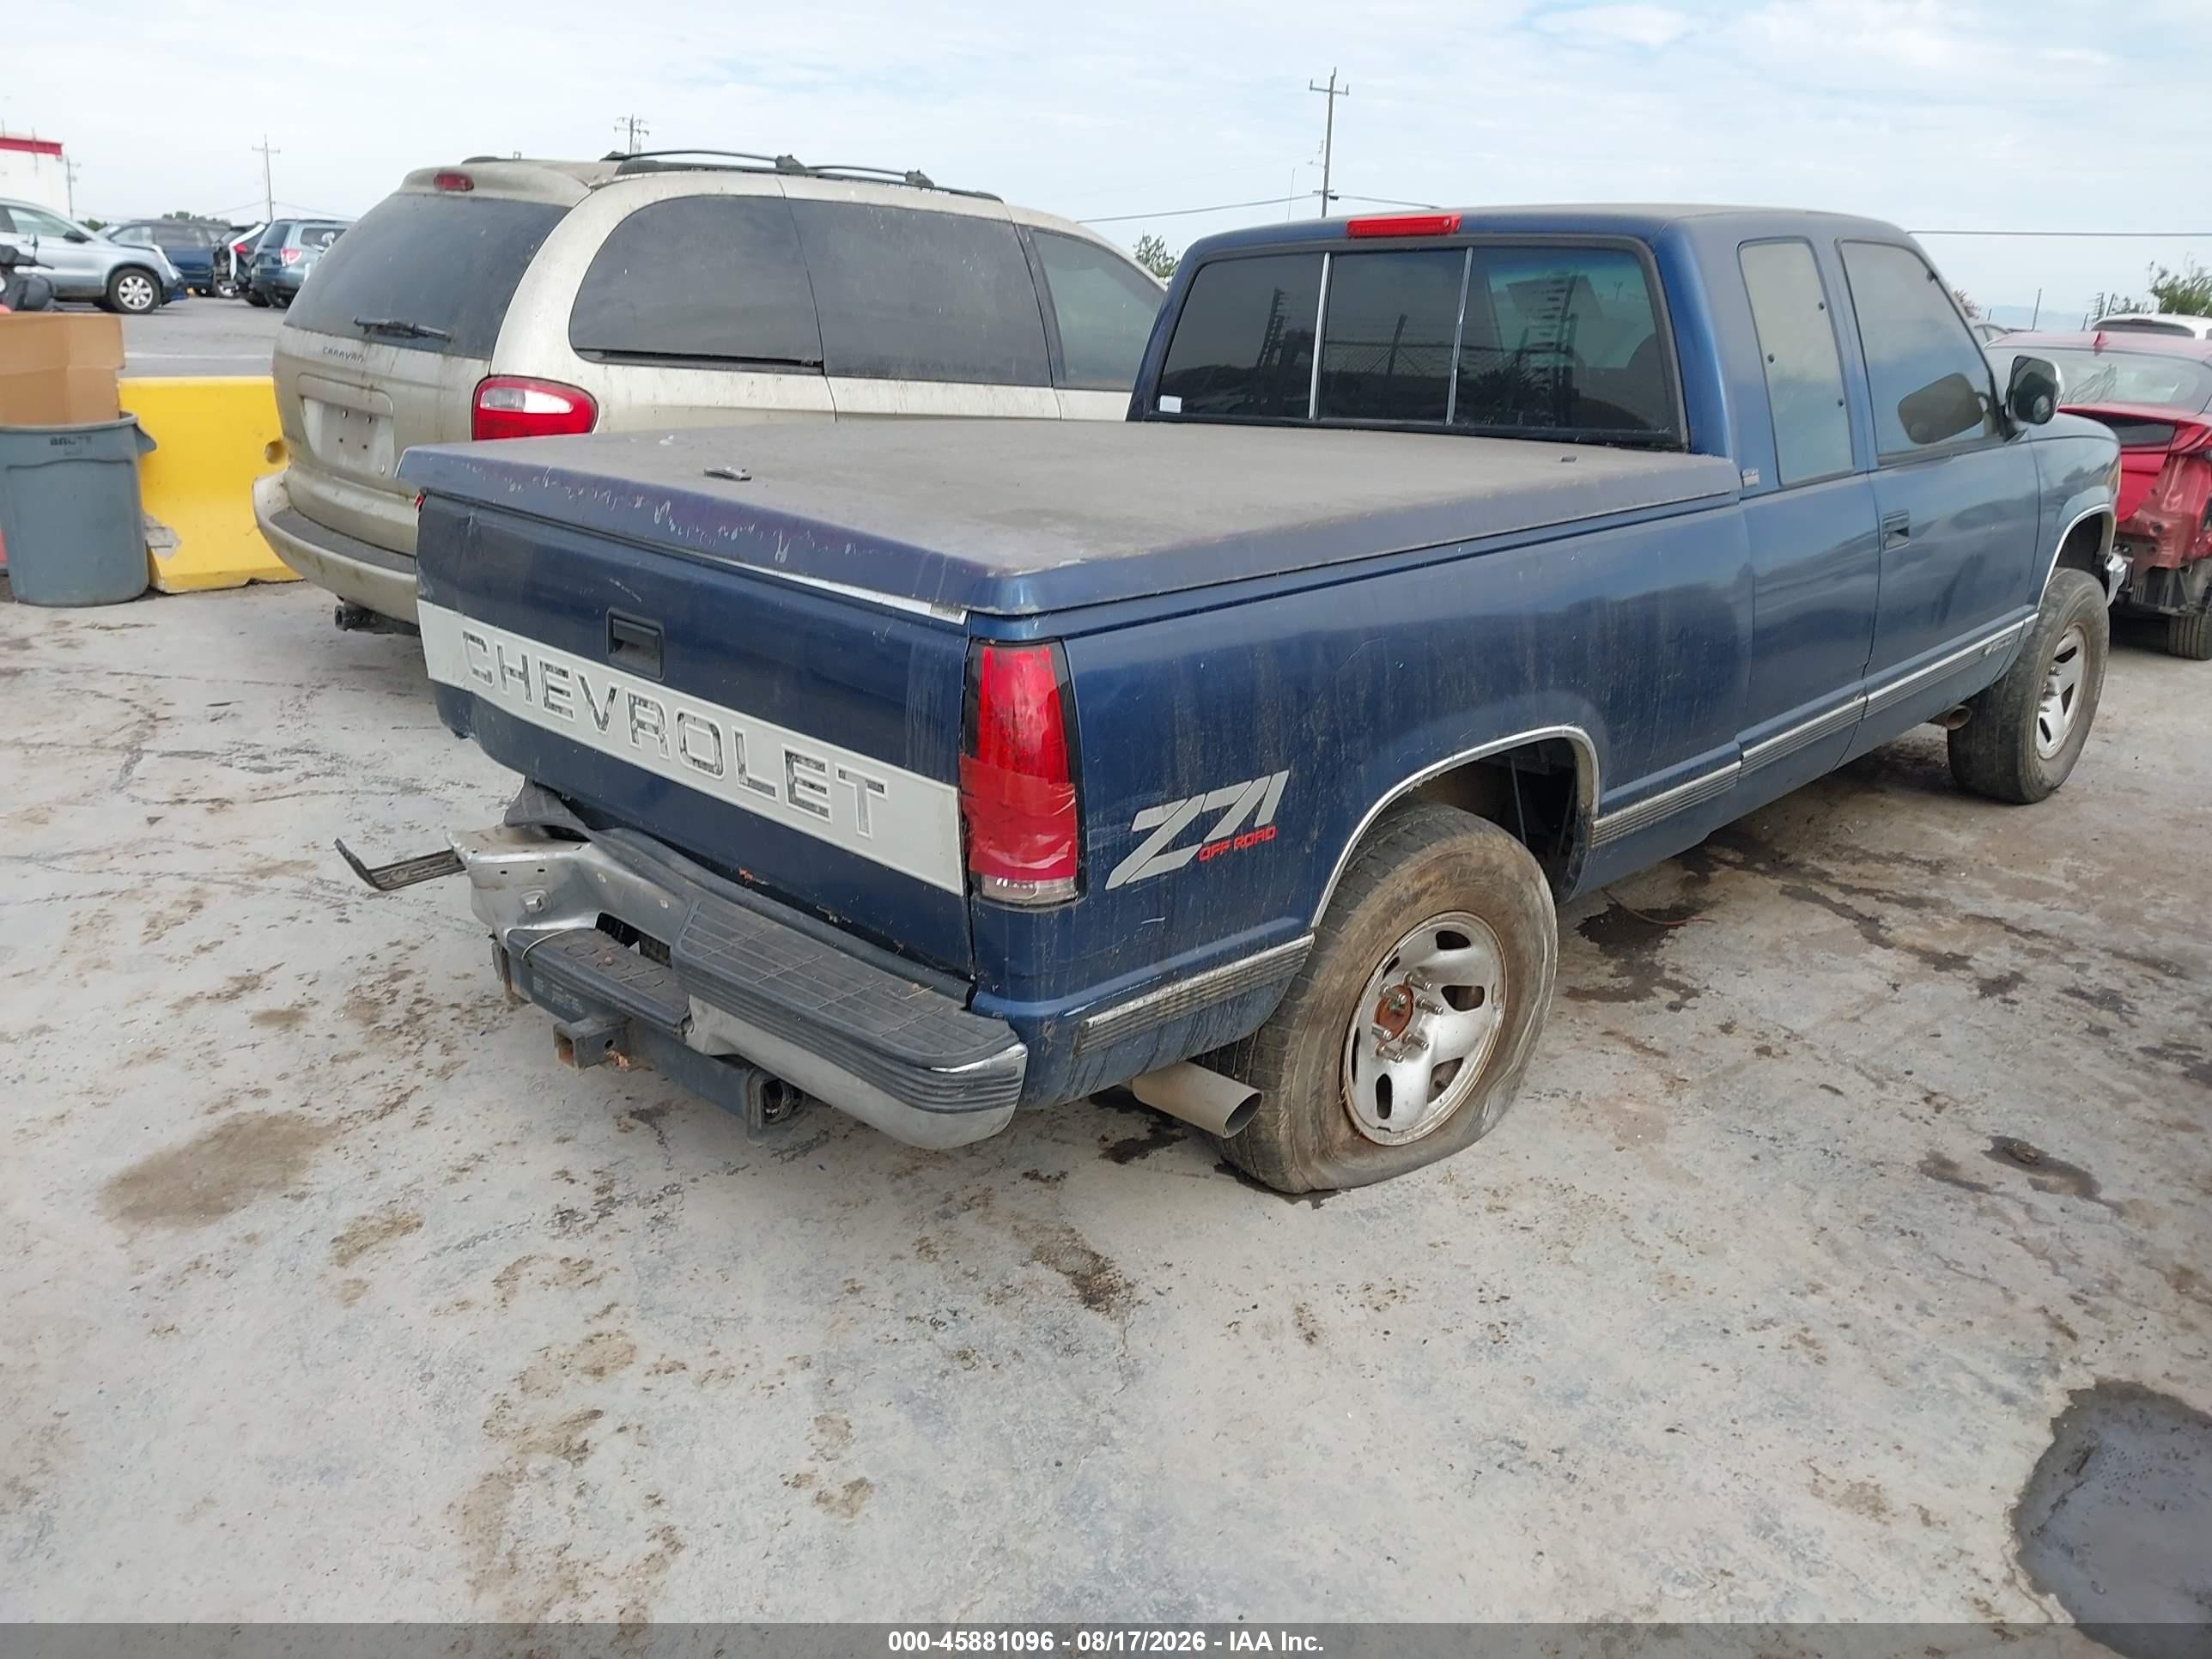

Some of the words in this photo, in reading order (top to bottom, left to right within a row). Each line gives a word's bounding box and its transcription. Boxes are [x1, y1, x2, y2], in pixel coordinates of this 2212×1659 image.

[322, 346, 364, 364] CARAVAN
[461, 629, 888, 838] CHEVROLET
[1105, 769, 1290, 890] Z71
[1198, 841, 1230, 861] OFF
[1234, 825, 1277, 850] ROAD
